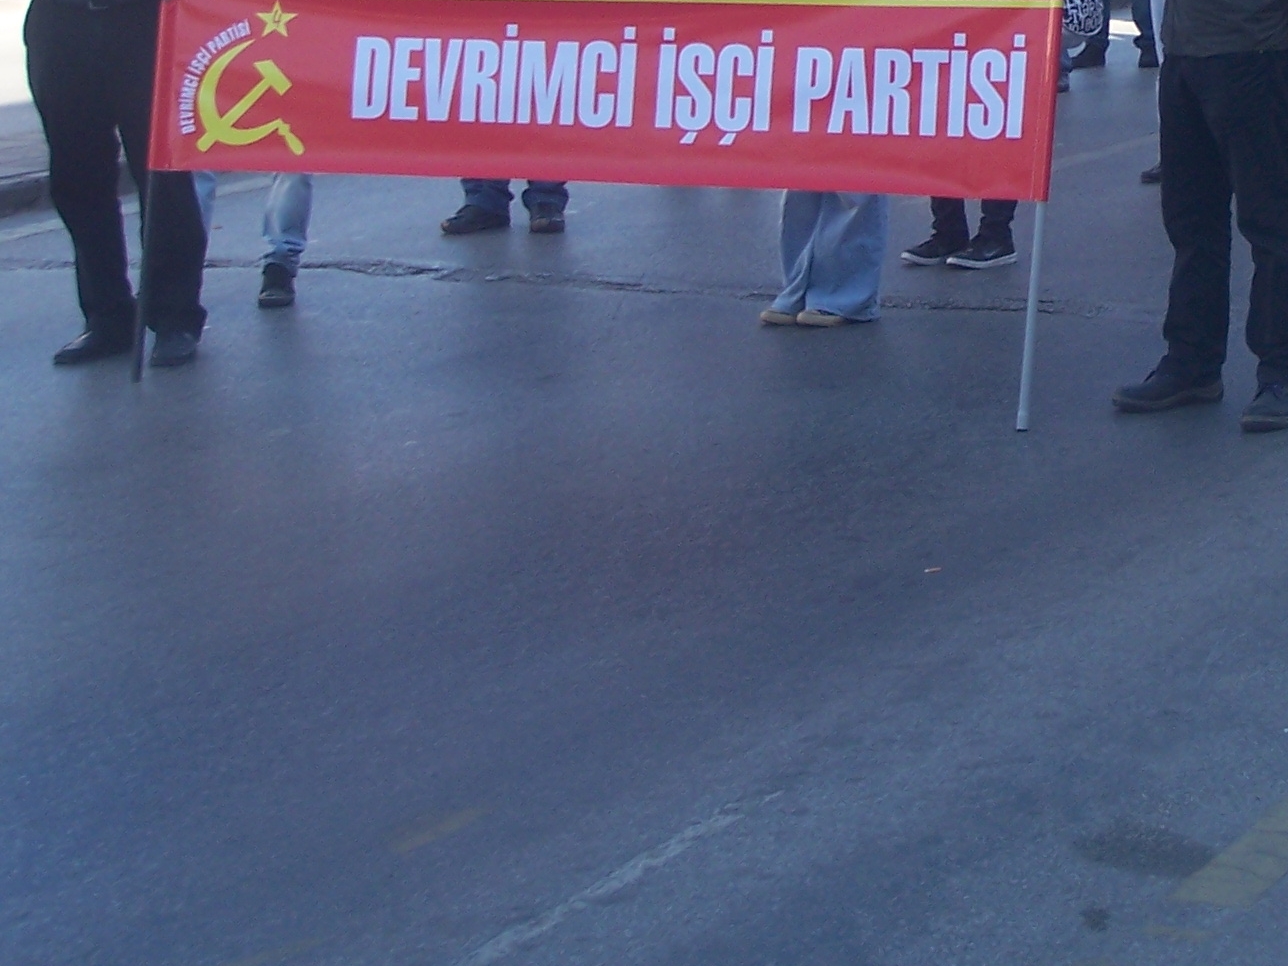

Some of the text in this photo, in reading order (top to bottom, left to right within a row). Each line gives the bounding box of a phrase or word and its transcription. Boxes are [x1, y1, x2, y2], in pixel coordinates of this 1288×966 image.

[352, 23, 1029, 146] DEVRİMCİ İŞÇİ PARTİSİ
